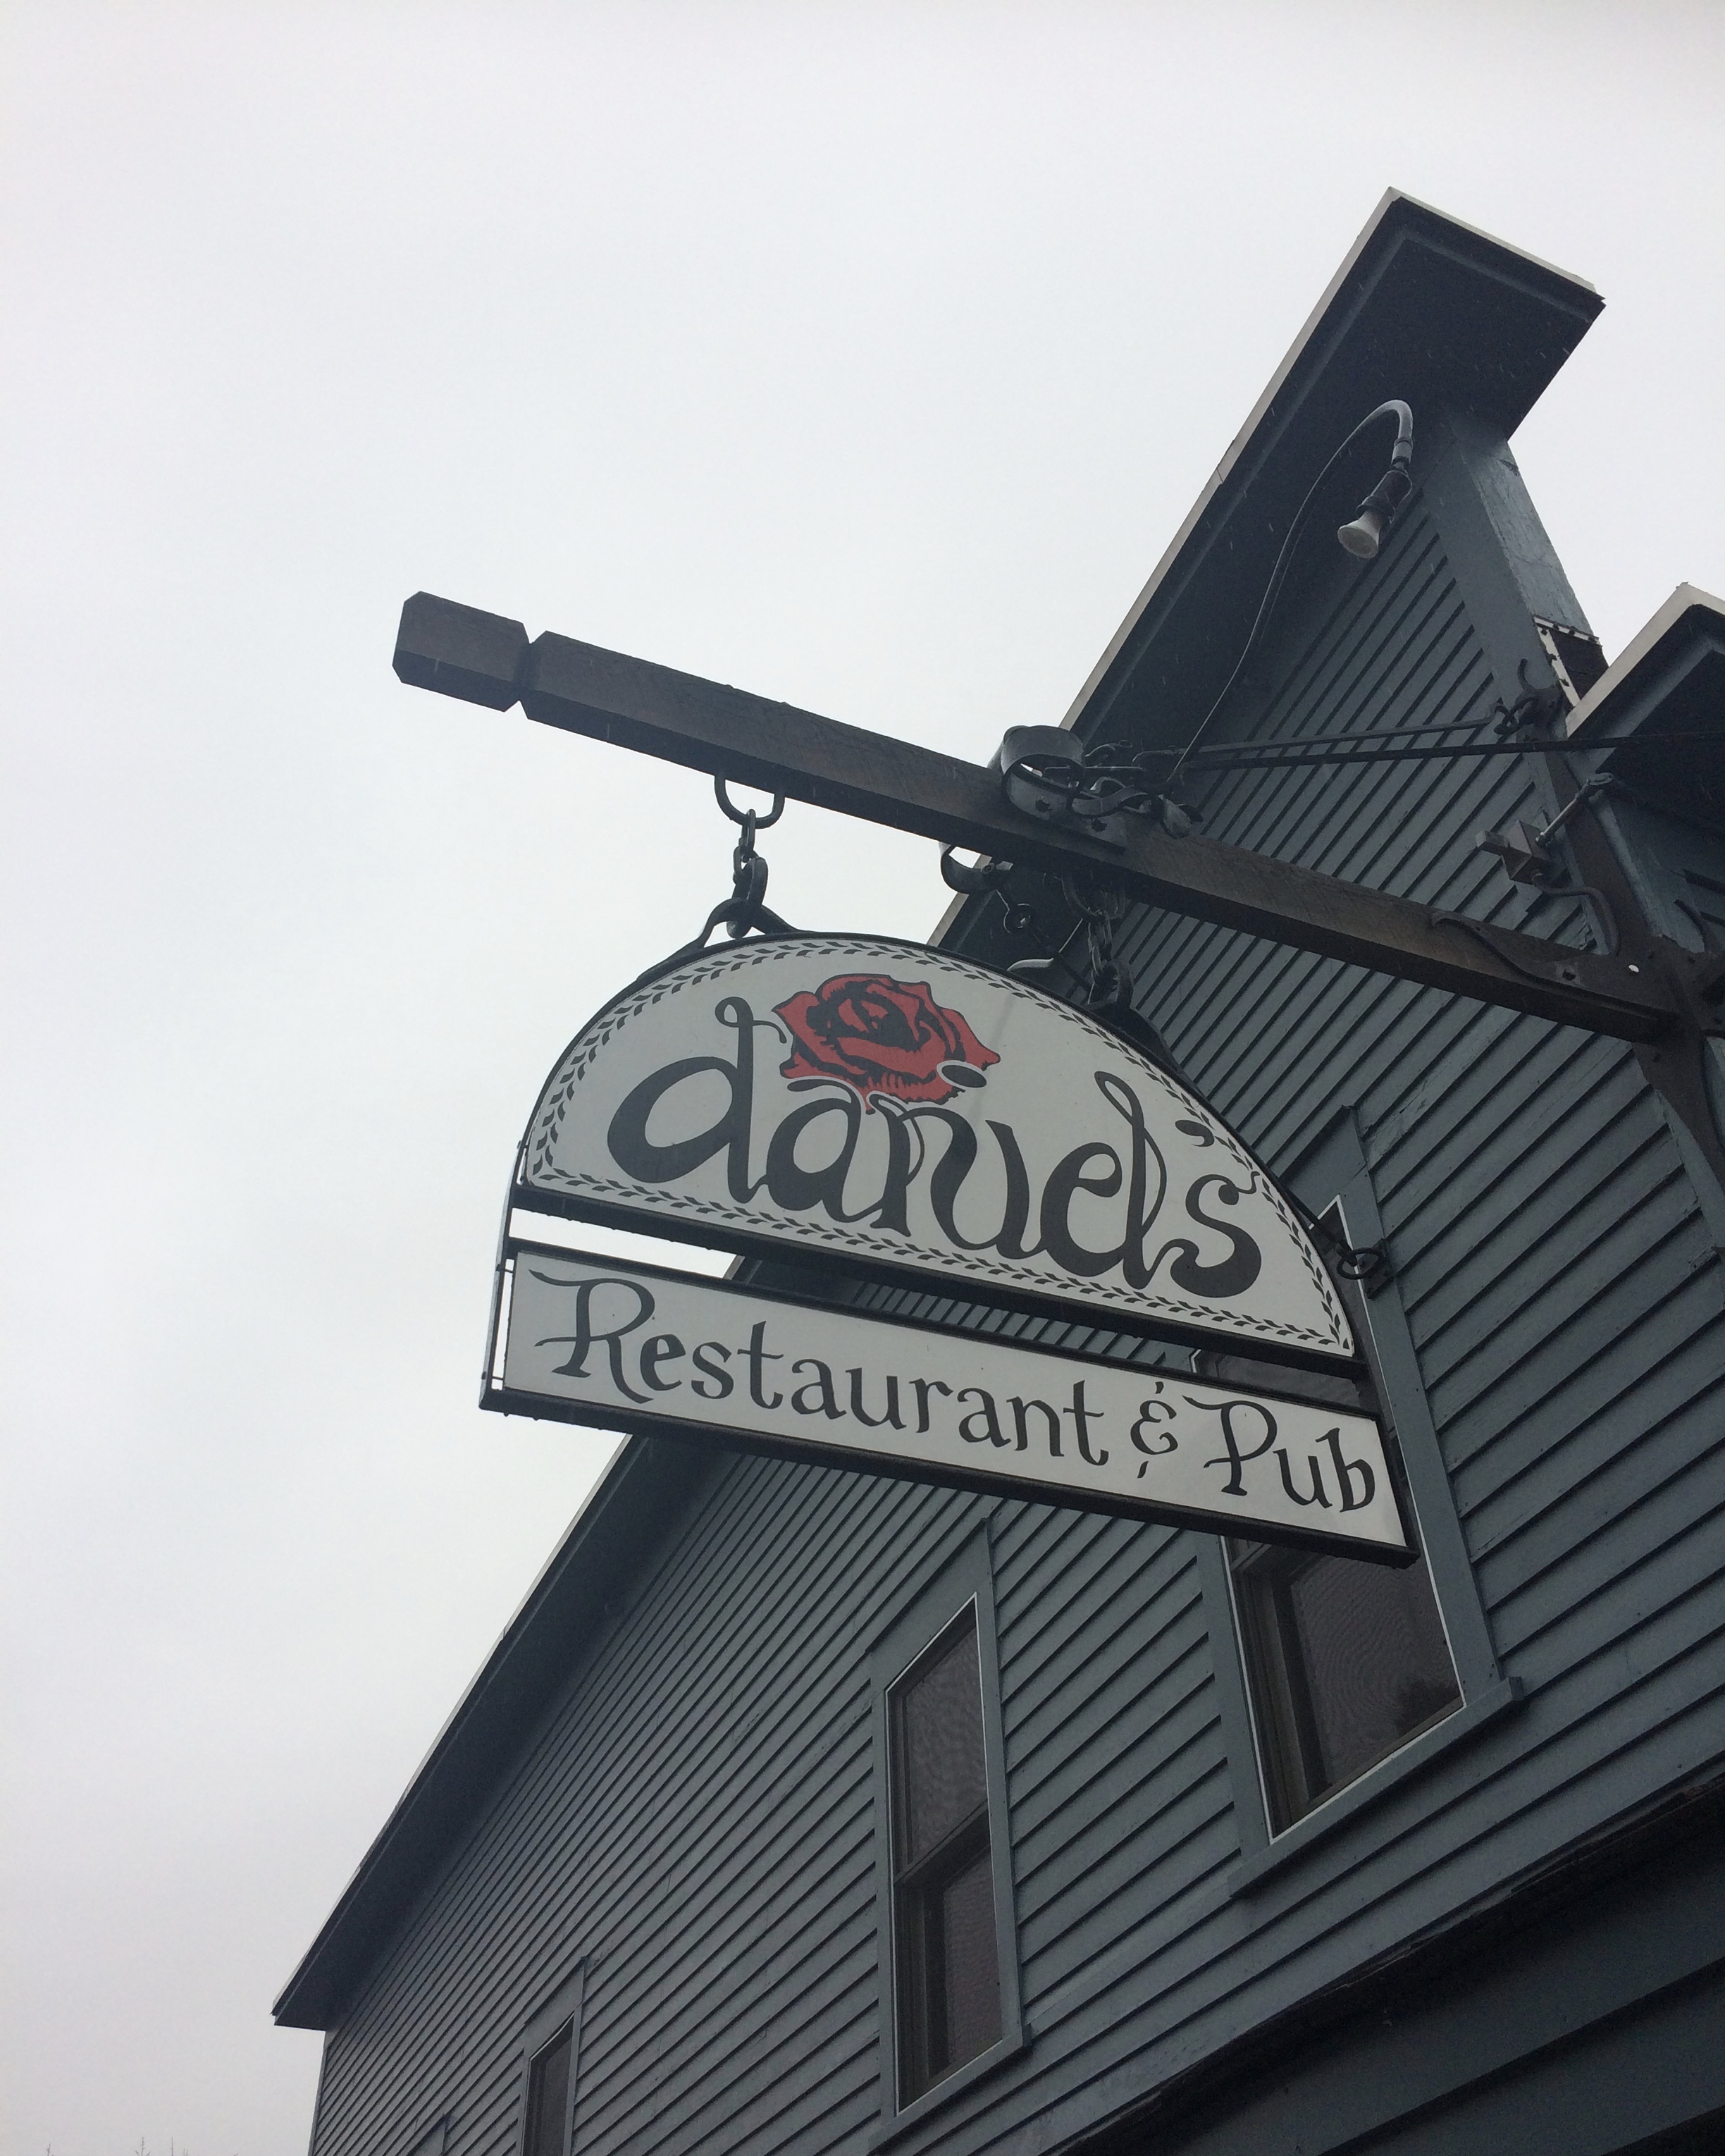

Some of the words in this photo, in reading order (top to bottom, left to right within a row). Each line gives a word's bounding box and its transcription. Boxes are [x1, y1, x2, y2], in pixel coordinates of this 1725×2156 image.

[607, 996, 1261, 1298] daniel's
[528, 1271, 1108, 1465] Restaurant
[1130, 1381, 1179, 1479] &
[1182, 1395, 1376, 1513] Pub
